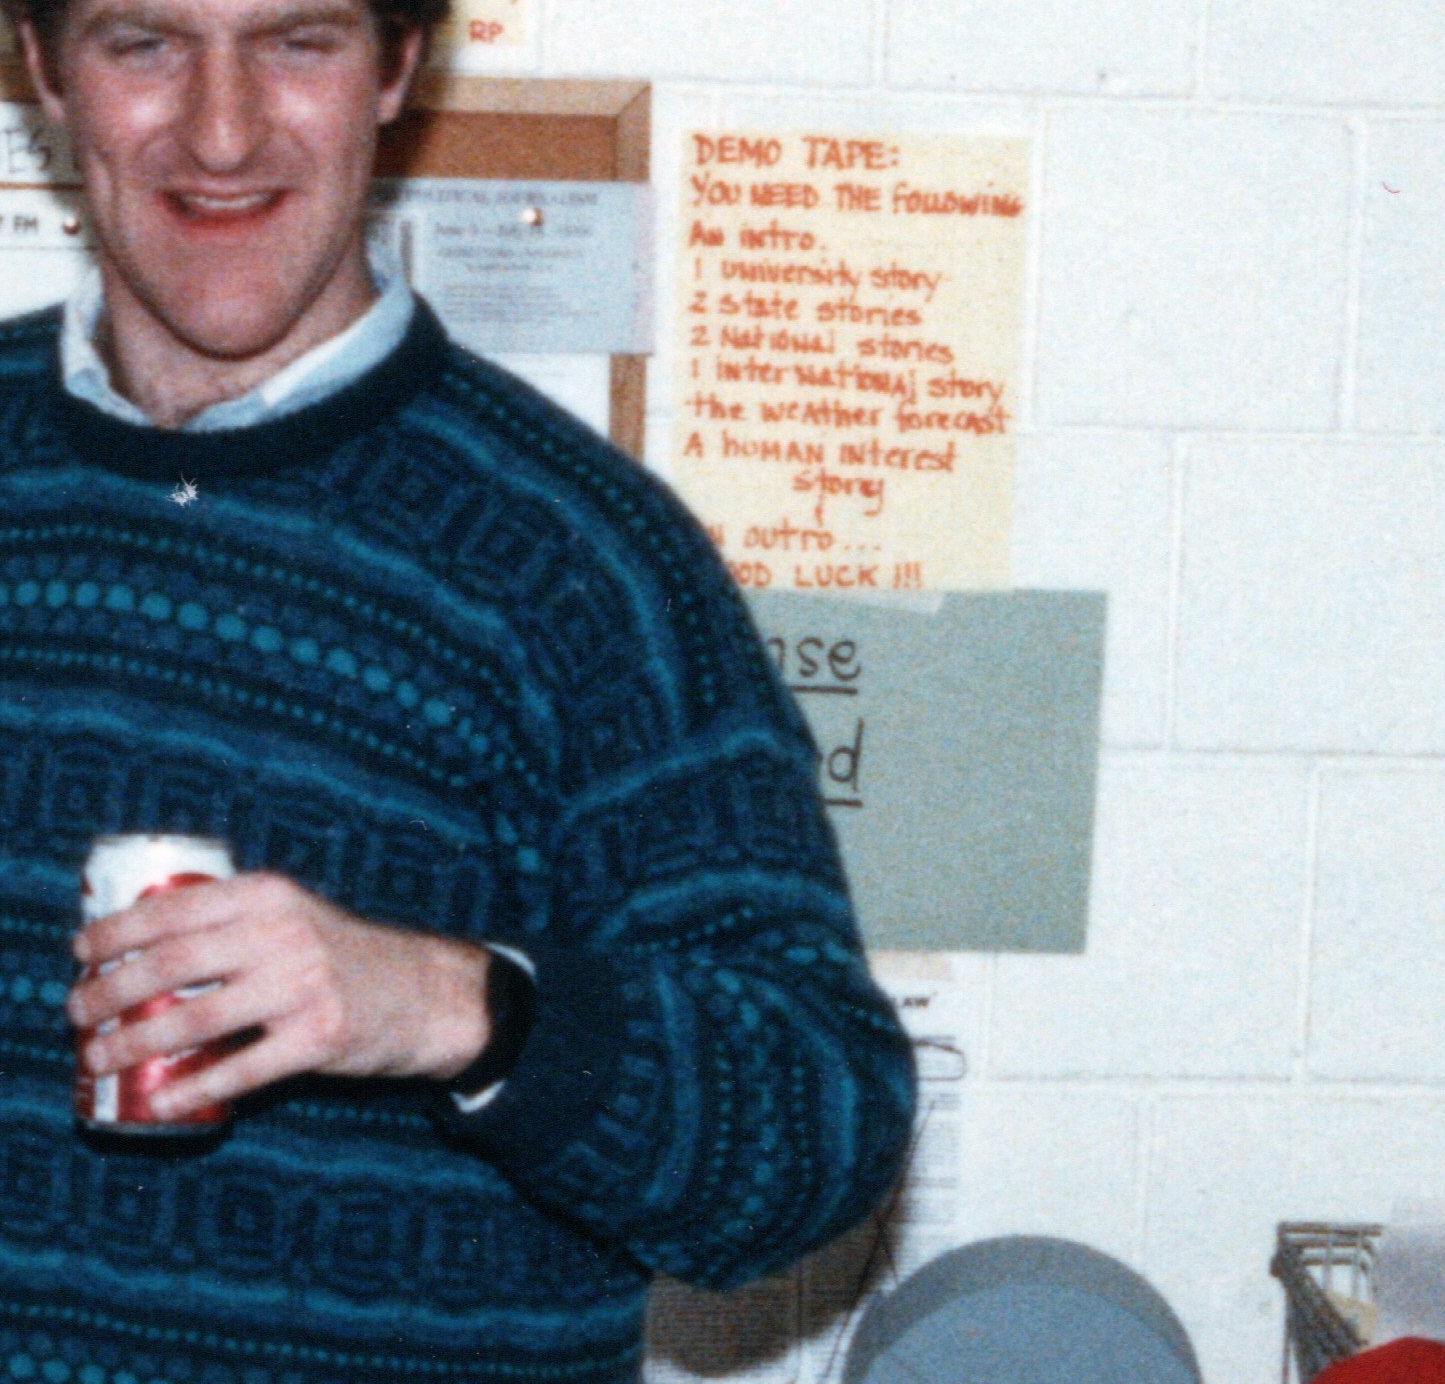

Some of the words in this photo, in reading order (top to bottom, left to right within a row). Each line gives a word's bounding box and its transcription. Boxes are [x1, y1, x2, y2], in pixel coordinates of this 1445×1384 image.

[692, 134, 782, 167] DEMO
[801, 136, 900, 170] TAPE:
[750, 181, 819, 210] NEED
[834, 182, 882, 212] THE
[13, 215, 38, 233] FM
[869, 261, 941, 303] story
[688, 291, 708, 315] 2
[689, 325, 709, 347] 2
[685, 390, 744, 422] the
[684, 430, 704, 459] A
[794, 563, 877, 589] LUCK
